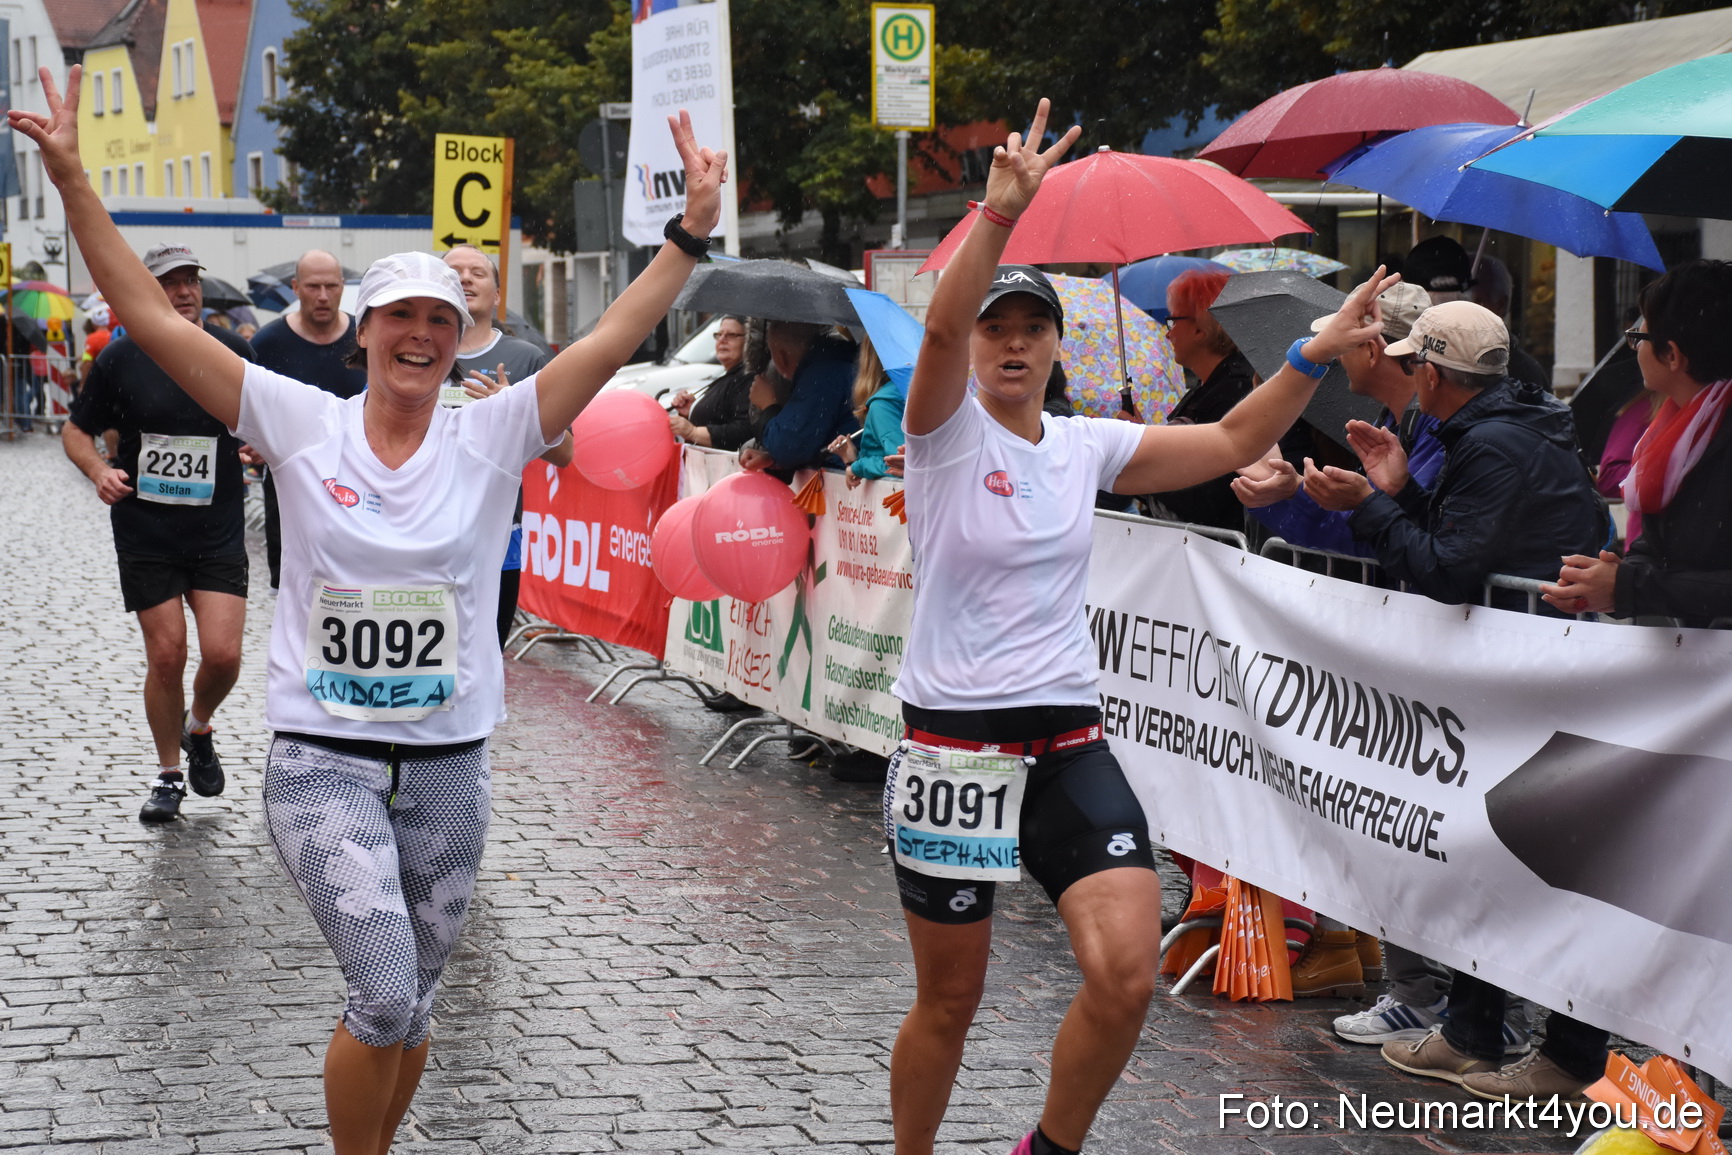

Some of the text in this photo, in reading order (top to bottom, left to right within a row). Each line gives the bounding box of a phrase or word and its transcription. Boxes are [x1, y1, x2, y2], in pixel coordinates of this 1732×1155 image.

[893, 24, 914, 50] H
[445, 140, 504, 164] Block
[453, 171, 492, 229] C
[146, 450, 209, 479] 2234
[158, 482, 191, 496] Stefan
[319, 596, 364, 609] NeuerMarkt
[372, 590, 446, 607] BOCK
[321, 616, 446, 670] 3092
[309, 670, 447, 709] ANDREA
[949, 753, 1016, 772] BOCK
[1135, 702, 1259, 782] VERBRAUCH.
[1257, 742, 1302, 806] MEHR
[1299, 764, 1448, 864] FAHRFREUDE.
[902, 774, 1008, 830] 3091
[896, 826, 1021, 869] STEPHANIE
